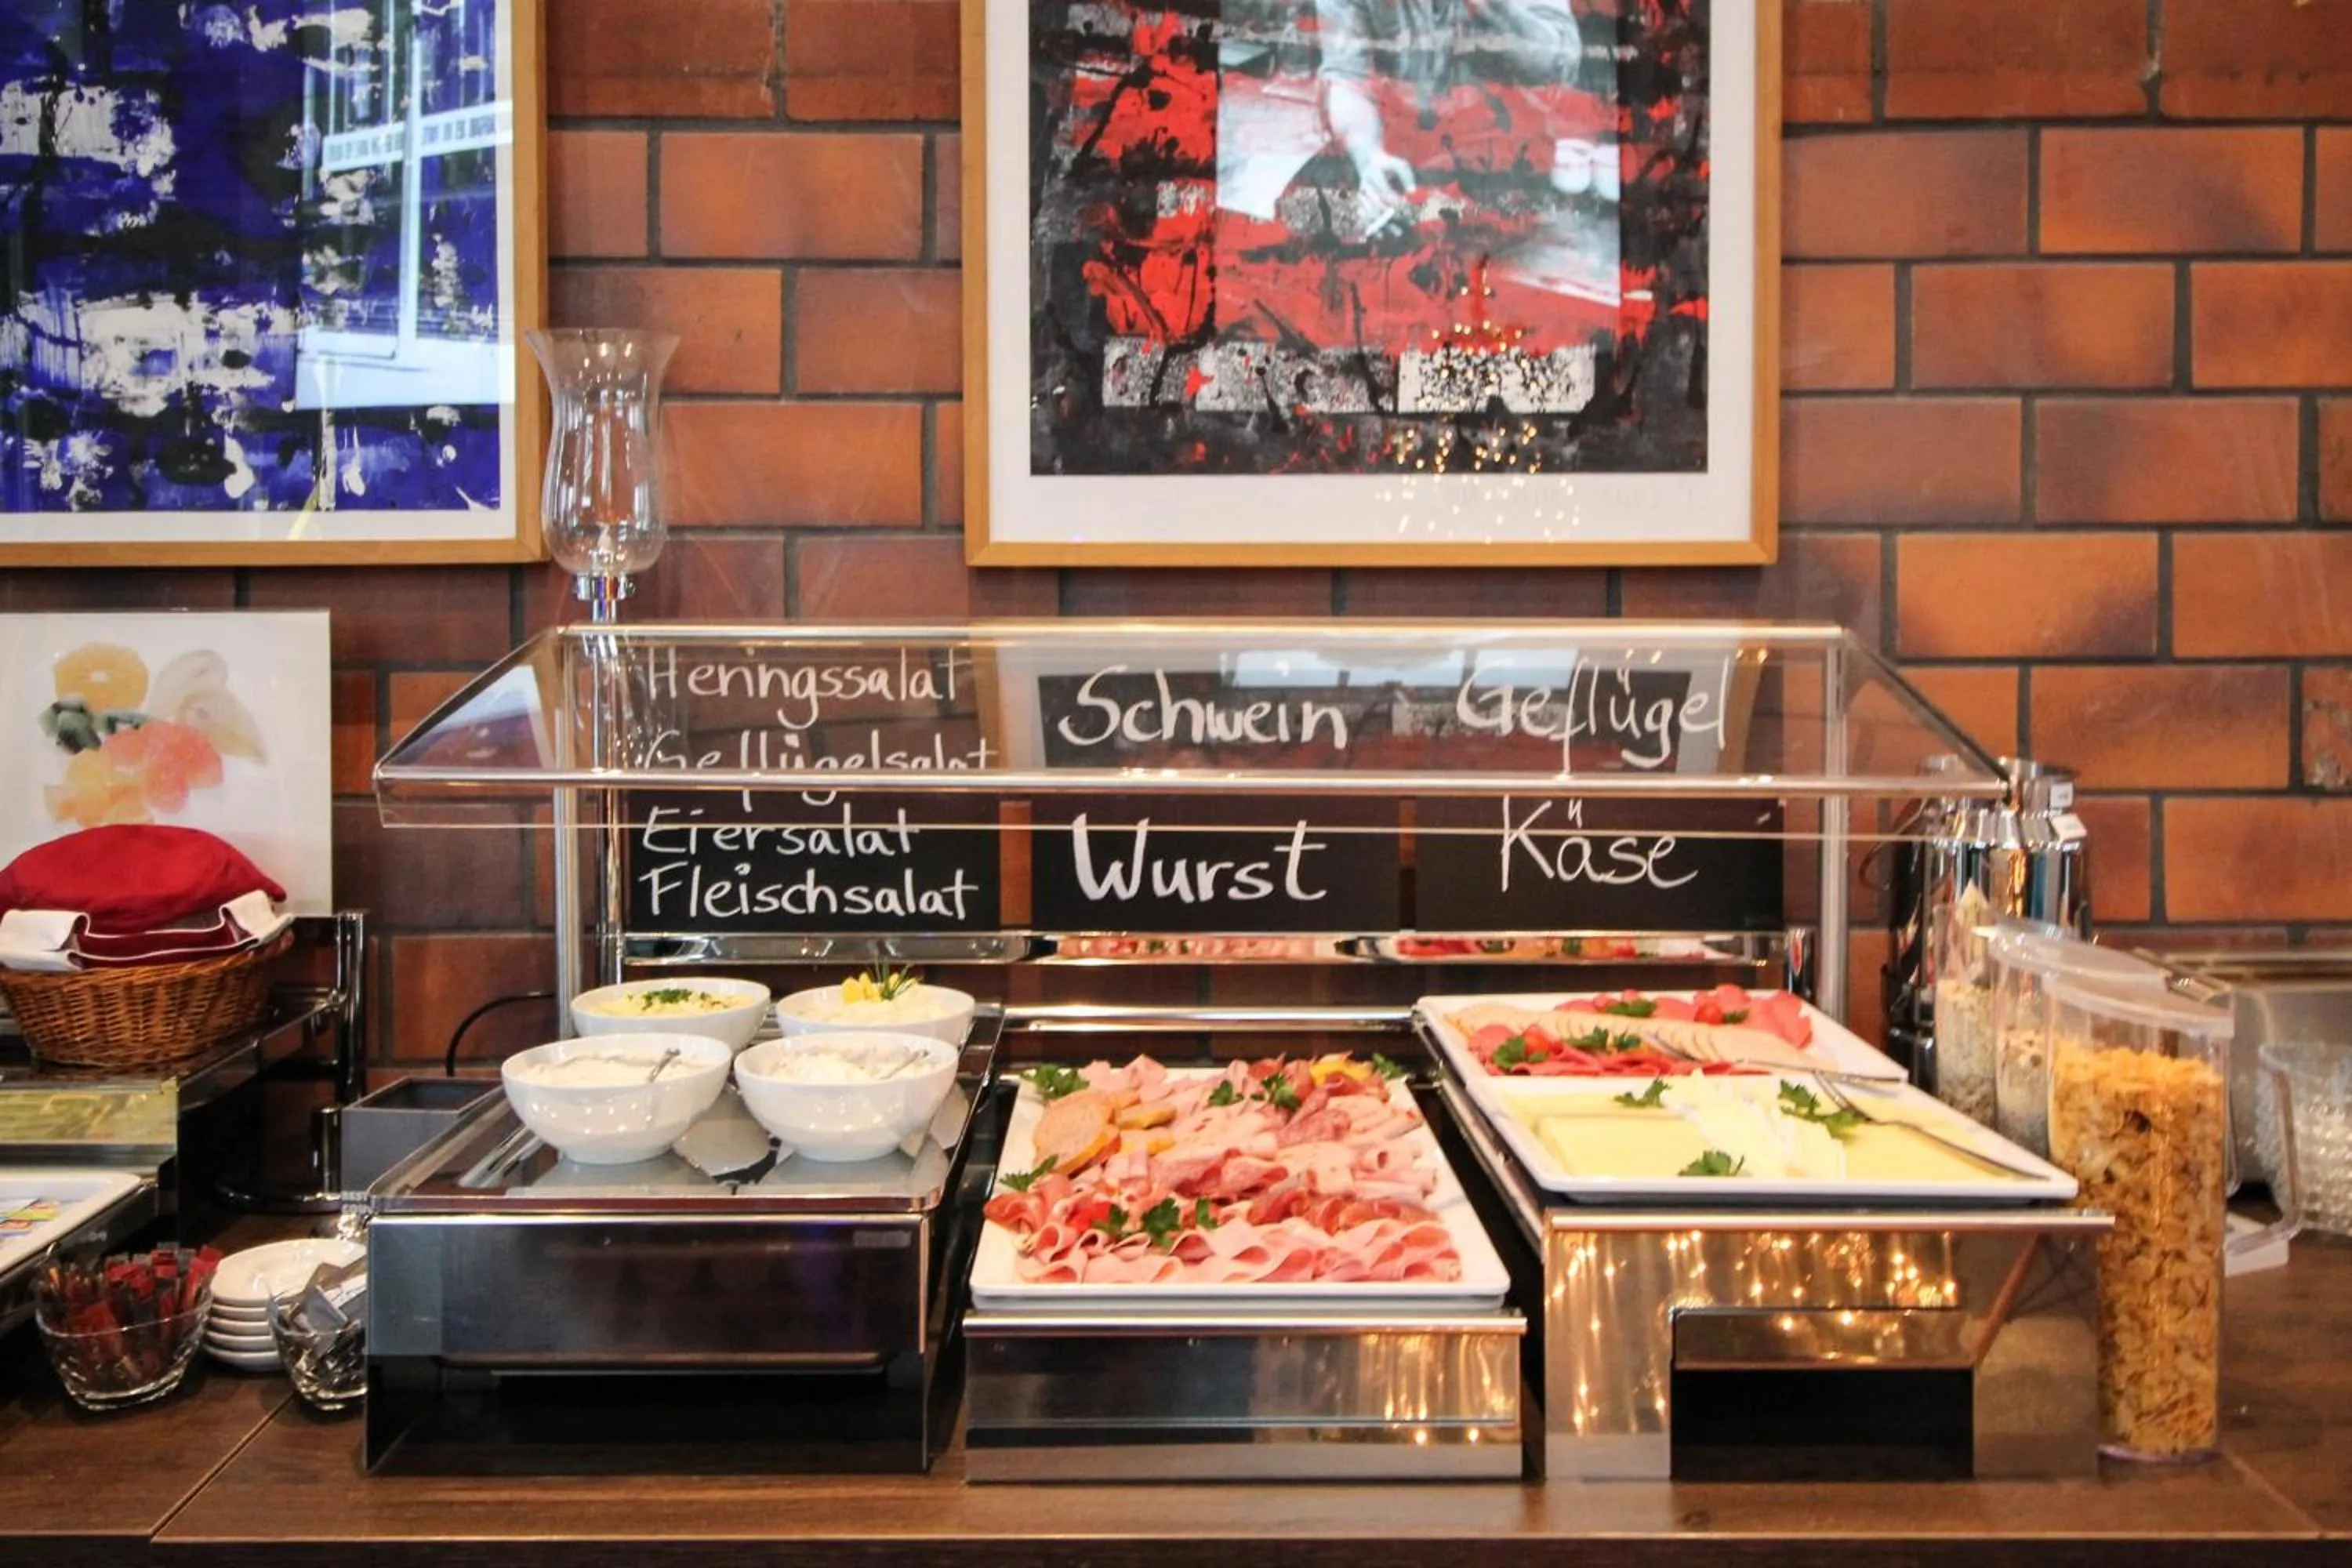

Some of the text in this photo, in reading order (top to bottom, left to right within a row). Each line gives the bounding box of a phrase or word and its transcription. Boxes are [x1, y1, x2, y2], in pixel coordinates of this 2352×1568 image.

[1058, 665, 1348, 750] Schwein
[1457, 655, 1730, 775] Geflügel
[643, 802, 920, 857] Eiersalat
[1072, 812, 1328, 904] Wurst
[1501, 794, 1699, 892] Käse
[638, 862, 979, 920] Fleischsalat
